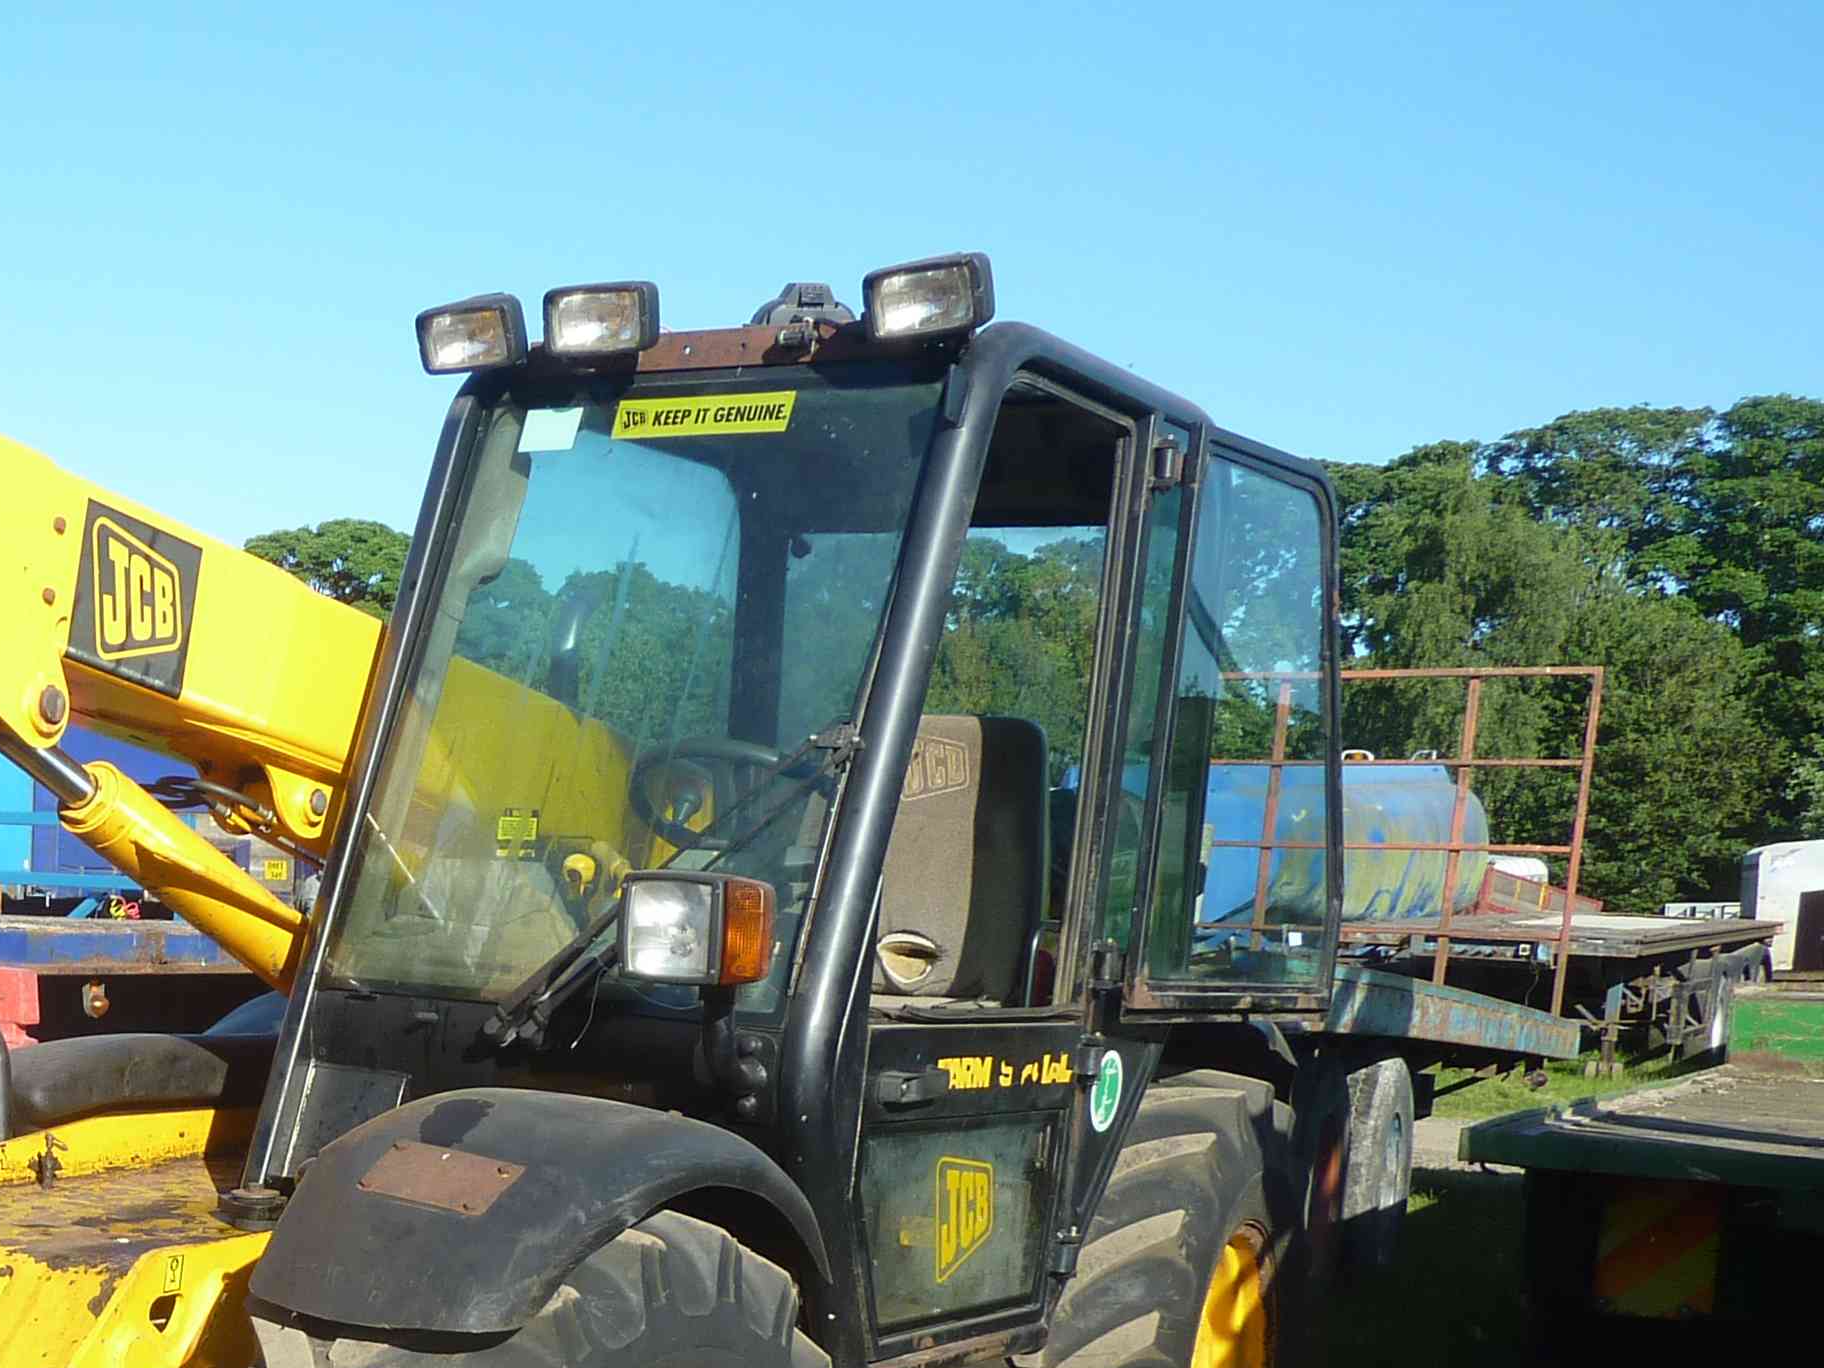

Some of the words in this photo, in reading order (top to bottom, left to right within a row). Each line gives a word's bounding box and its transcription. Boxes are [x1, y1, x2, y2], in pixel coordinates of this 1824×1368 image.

[652, 408, 692, 428] KEEP
[694, 407, 710, 424] IT
[101, 535, 176, 645] JCB
[940, 1168, 989, 1270] JCB
